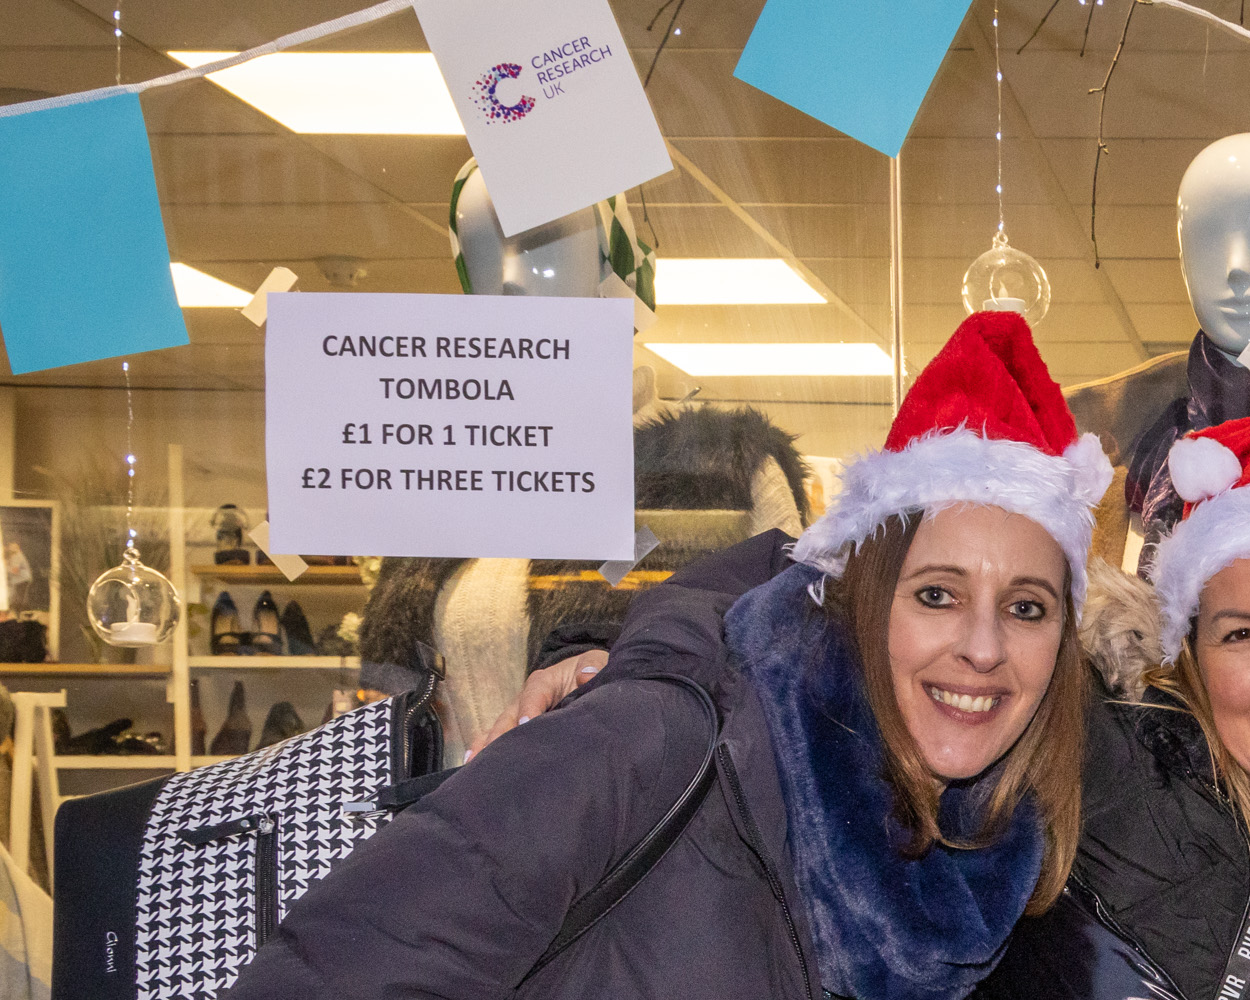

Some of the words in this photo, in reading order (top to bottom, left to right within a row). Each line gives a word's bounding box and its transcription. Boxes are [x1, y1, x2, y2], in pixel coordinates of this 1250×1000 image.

[530, 36, 592, 70] CANCER
[536, 44, 613, 84] RESEARCH
[542, 82, 566, 100] UK
[322, 335, 428, 358] CANCER
[436, 336, 570, 360] RESEARCH
[379, 378, 515, 401] TOMBOLA
[342, 422, 372, 444] £1
[382, 424, 434, 446] FOR
[442, 424, 456, 446] 1
[464, 424, 554, 448] TICKET
[302, 467, 332, 490] £2
[340, 468, 392, 490] FOR
[400, 469, 484, 492] THREE
[492, 470, 596, 494] TICKETS
